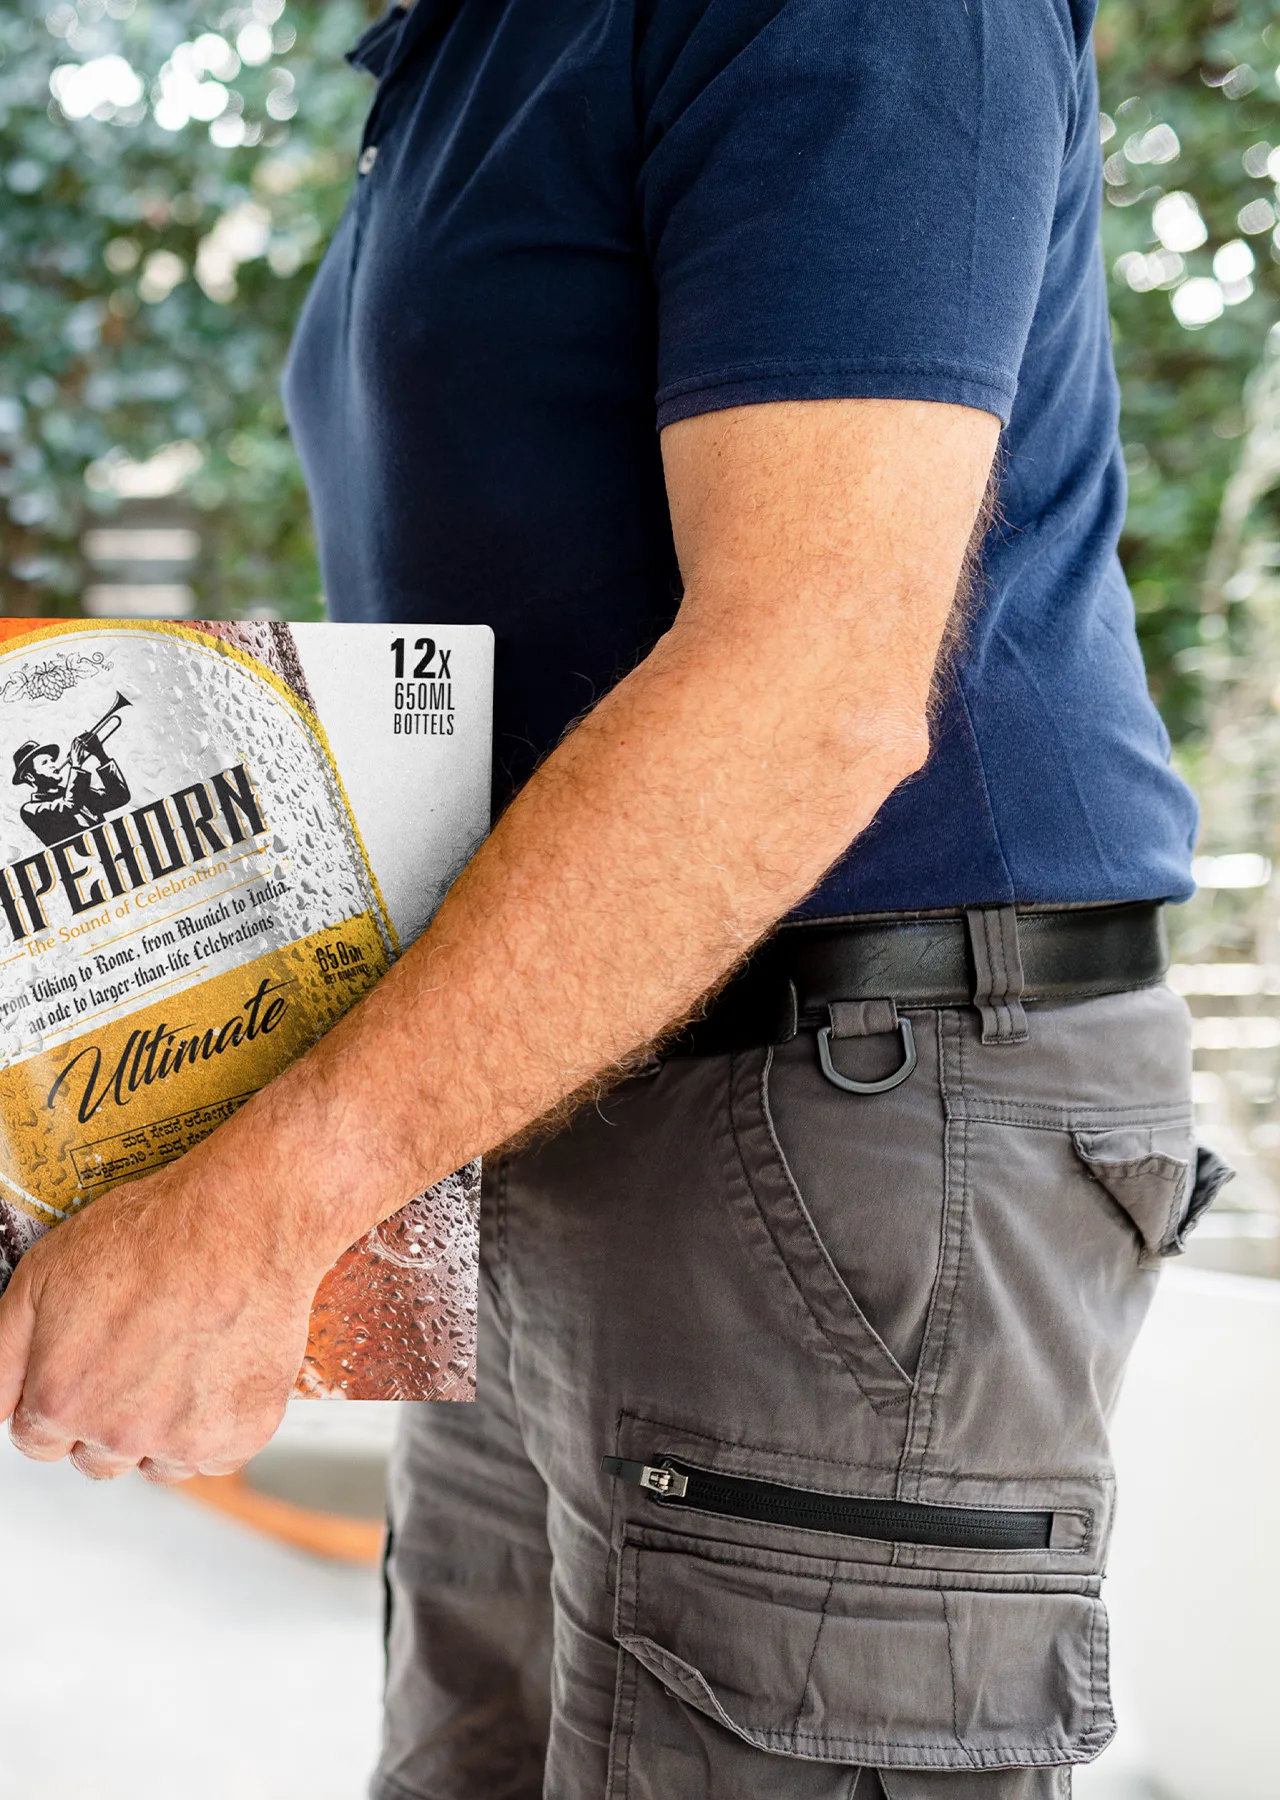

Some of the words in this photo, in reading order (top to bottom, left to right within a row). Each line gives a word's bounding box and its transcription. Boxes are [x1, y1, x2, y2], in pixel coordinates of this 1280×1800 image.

[393, 713, 454, 735] BOTTELS
[394, 682, 455, 710] 650ML
[24, 938, 56, 957] The
[58, 909, 111, 943] Sound
[115, 901, 131, 918] of
[135, 863, 228, 909] Celebration
[79, 966, 93, 982] to
[142, 930, 176, 955] from
[174, 902, 230, 940] Munich
[232, 897, 246, 915] to
[28, 1018, 46, 1034] an
[47, 1002, 71, 1025] ode
[74, 997, 87, 1014] to
[89, 949, 191, 1007] larger-than-life
[193, 915, 274, 961] Celebrations
[47, 978, 298, 1124] Ultimate
